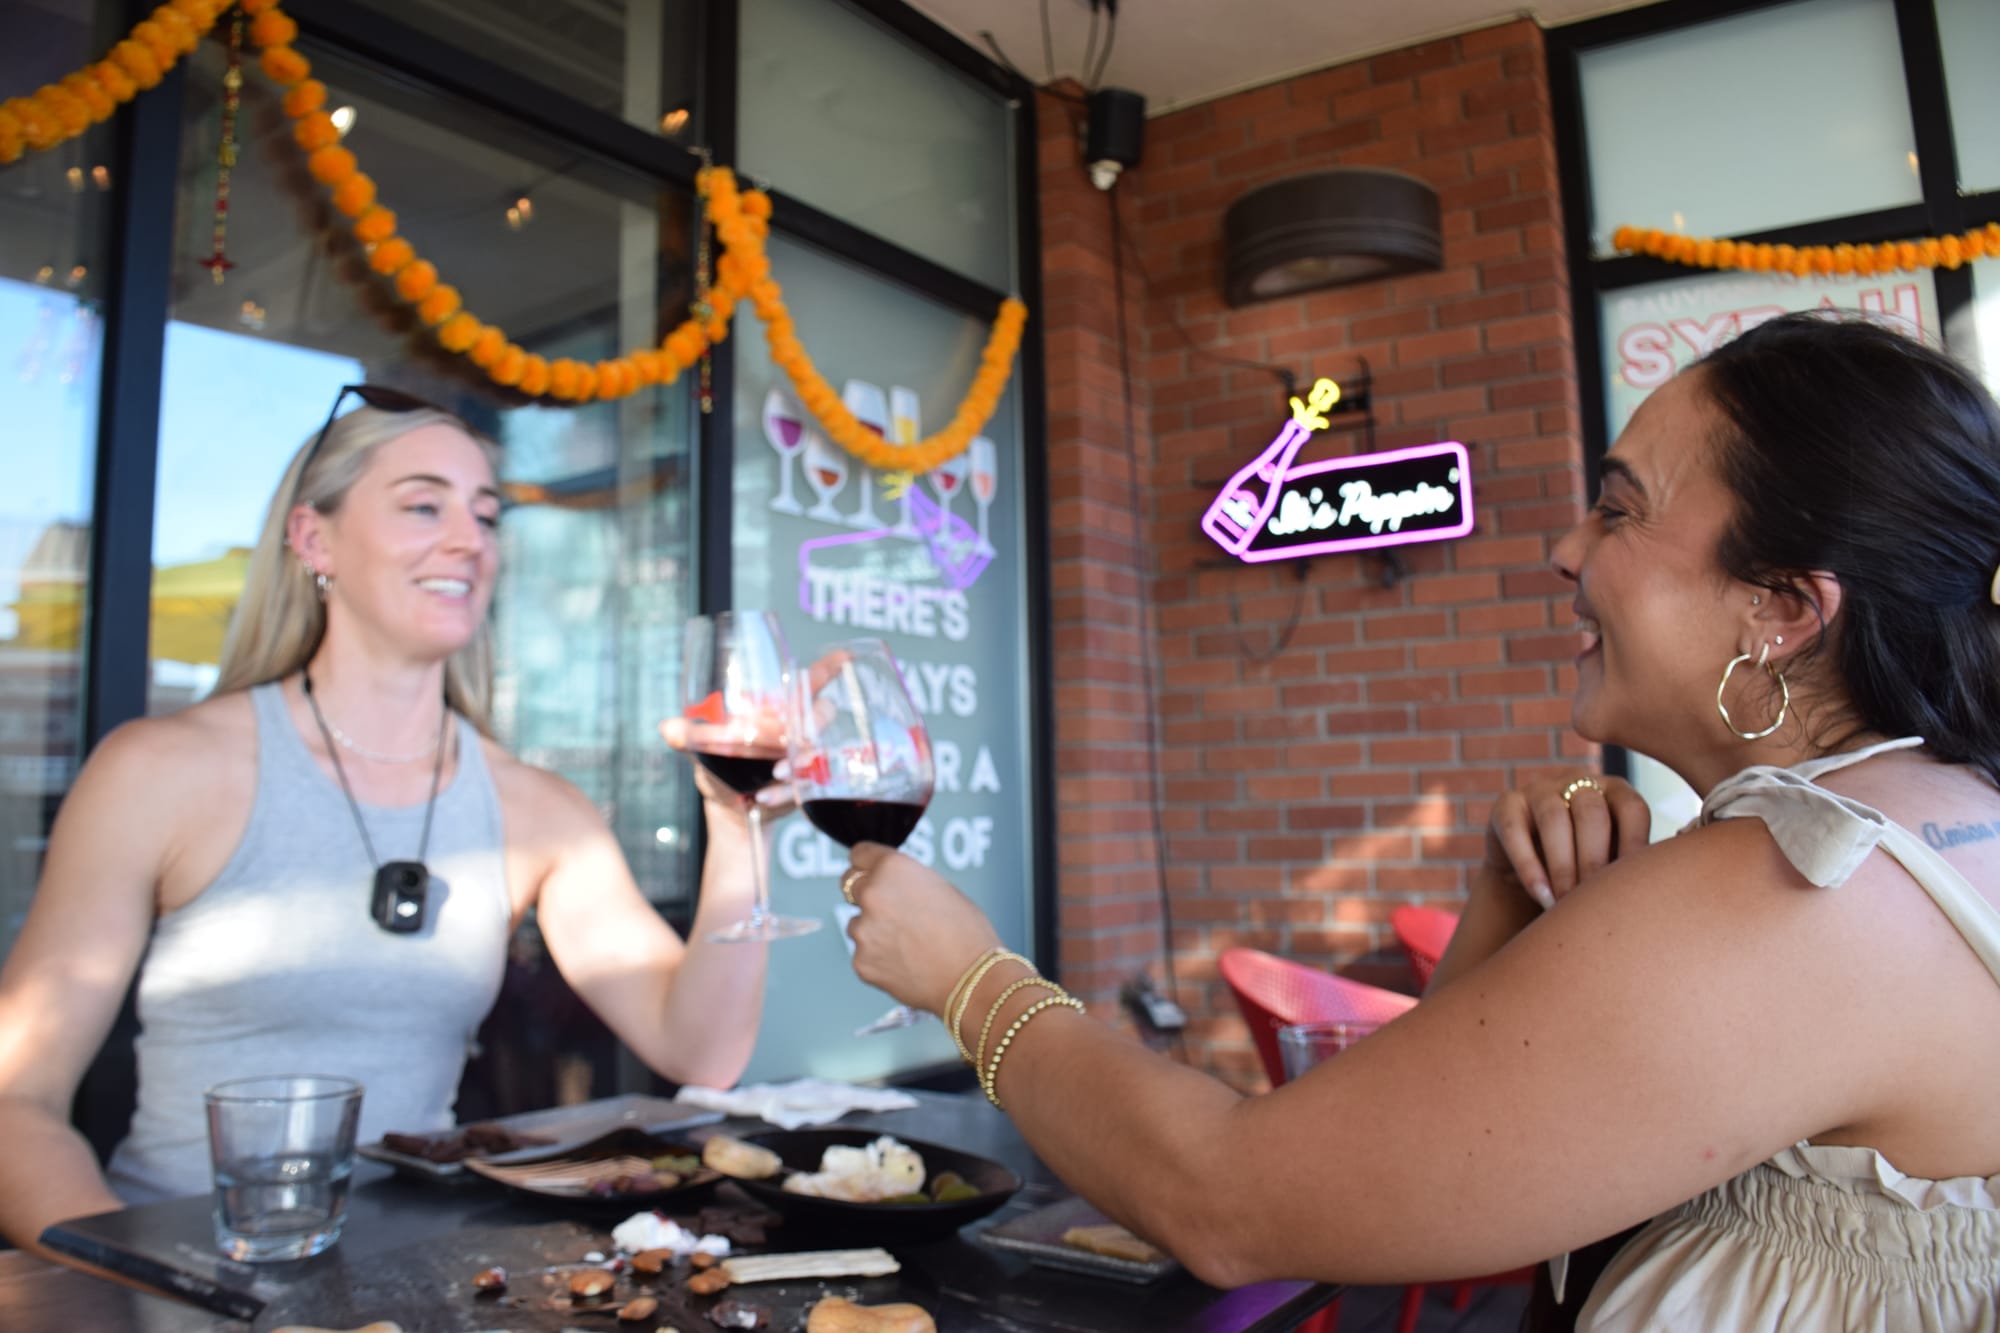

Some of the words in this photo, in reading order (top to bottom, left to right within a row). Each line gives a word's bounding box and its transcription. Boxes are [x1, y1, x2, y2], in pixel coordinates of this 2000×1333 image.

[1618, 283, 1925, 388] SYH
[968, 743, 1001, 793] A
[778, 817, 935, 880] GLS
[941, 816, 994, 870] OF
